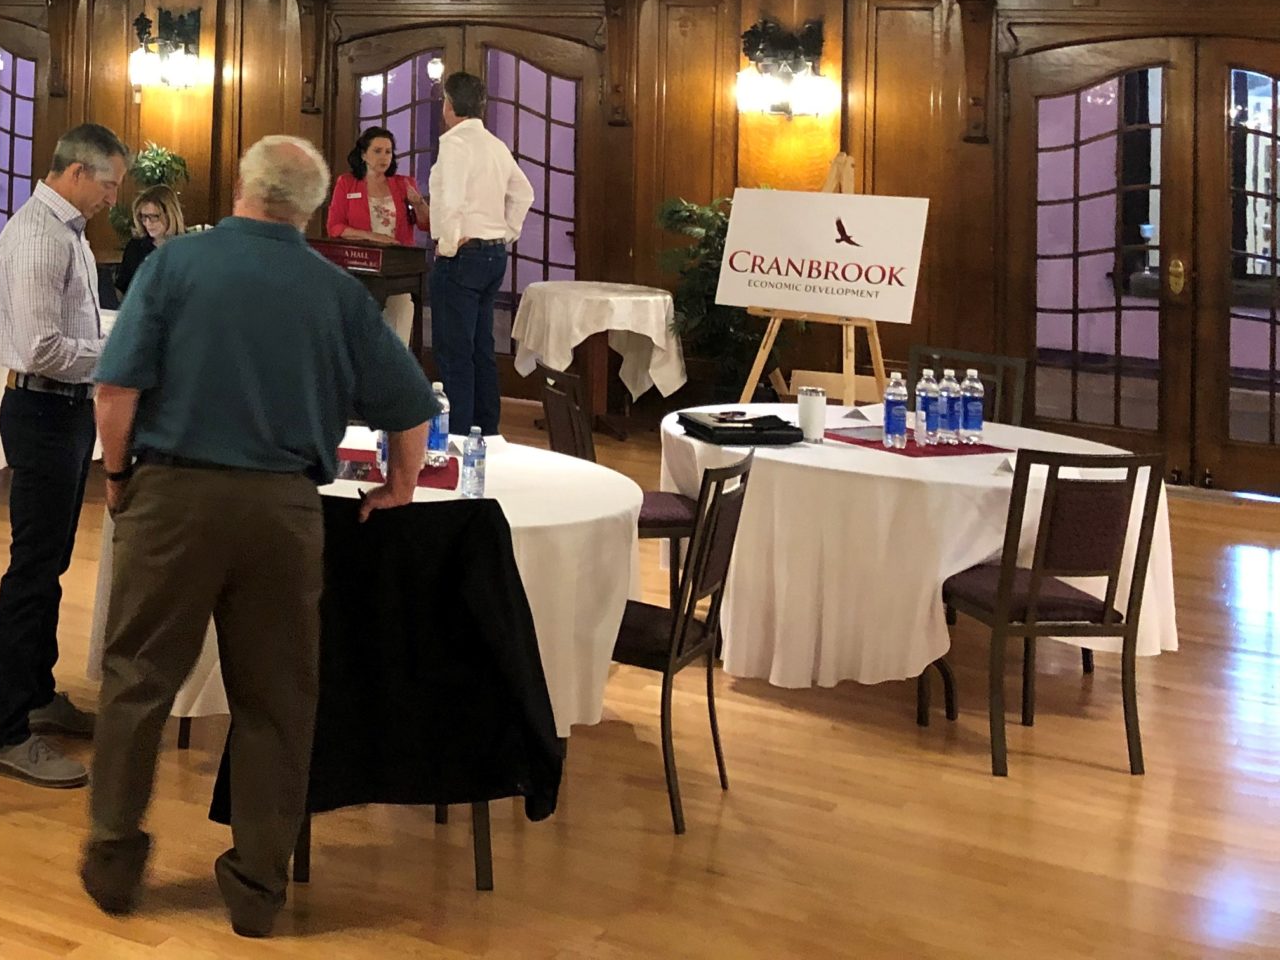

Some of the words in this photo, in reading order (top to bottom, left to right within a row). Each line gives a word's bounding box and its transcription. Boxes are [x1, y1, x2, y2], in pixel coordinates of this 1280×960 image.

[728, 249, 907, 287] CRANBROOK
[747, 279, 802, 292] ECONOMIC
[804, 284, 880, 299] DEVELOPMENT
